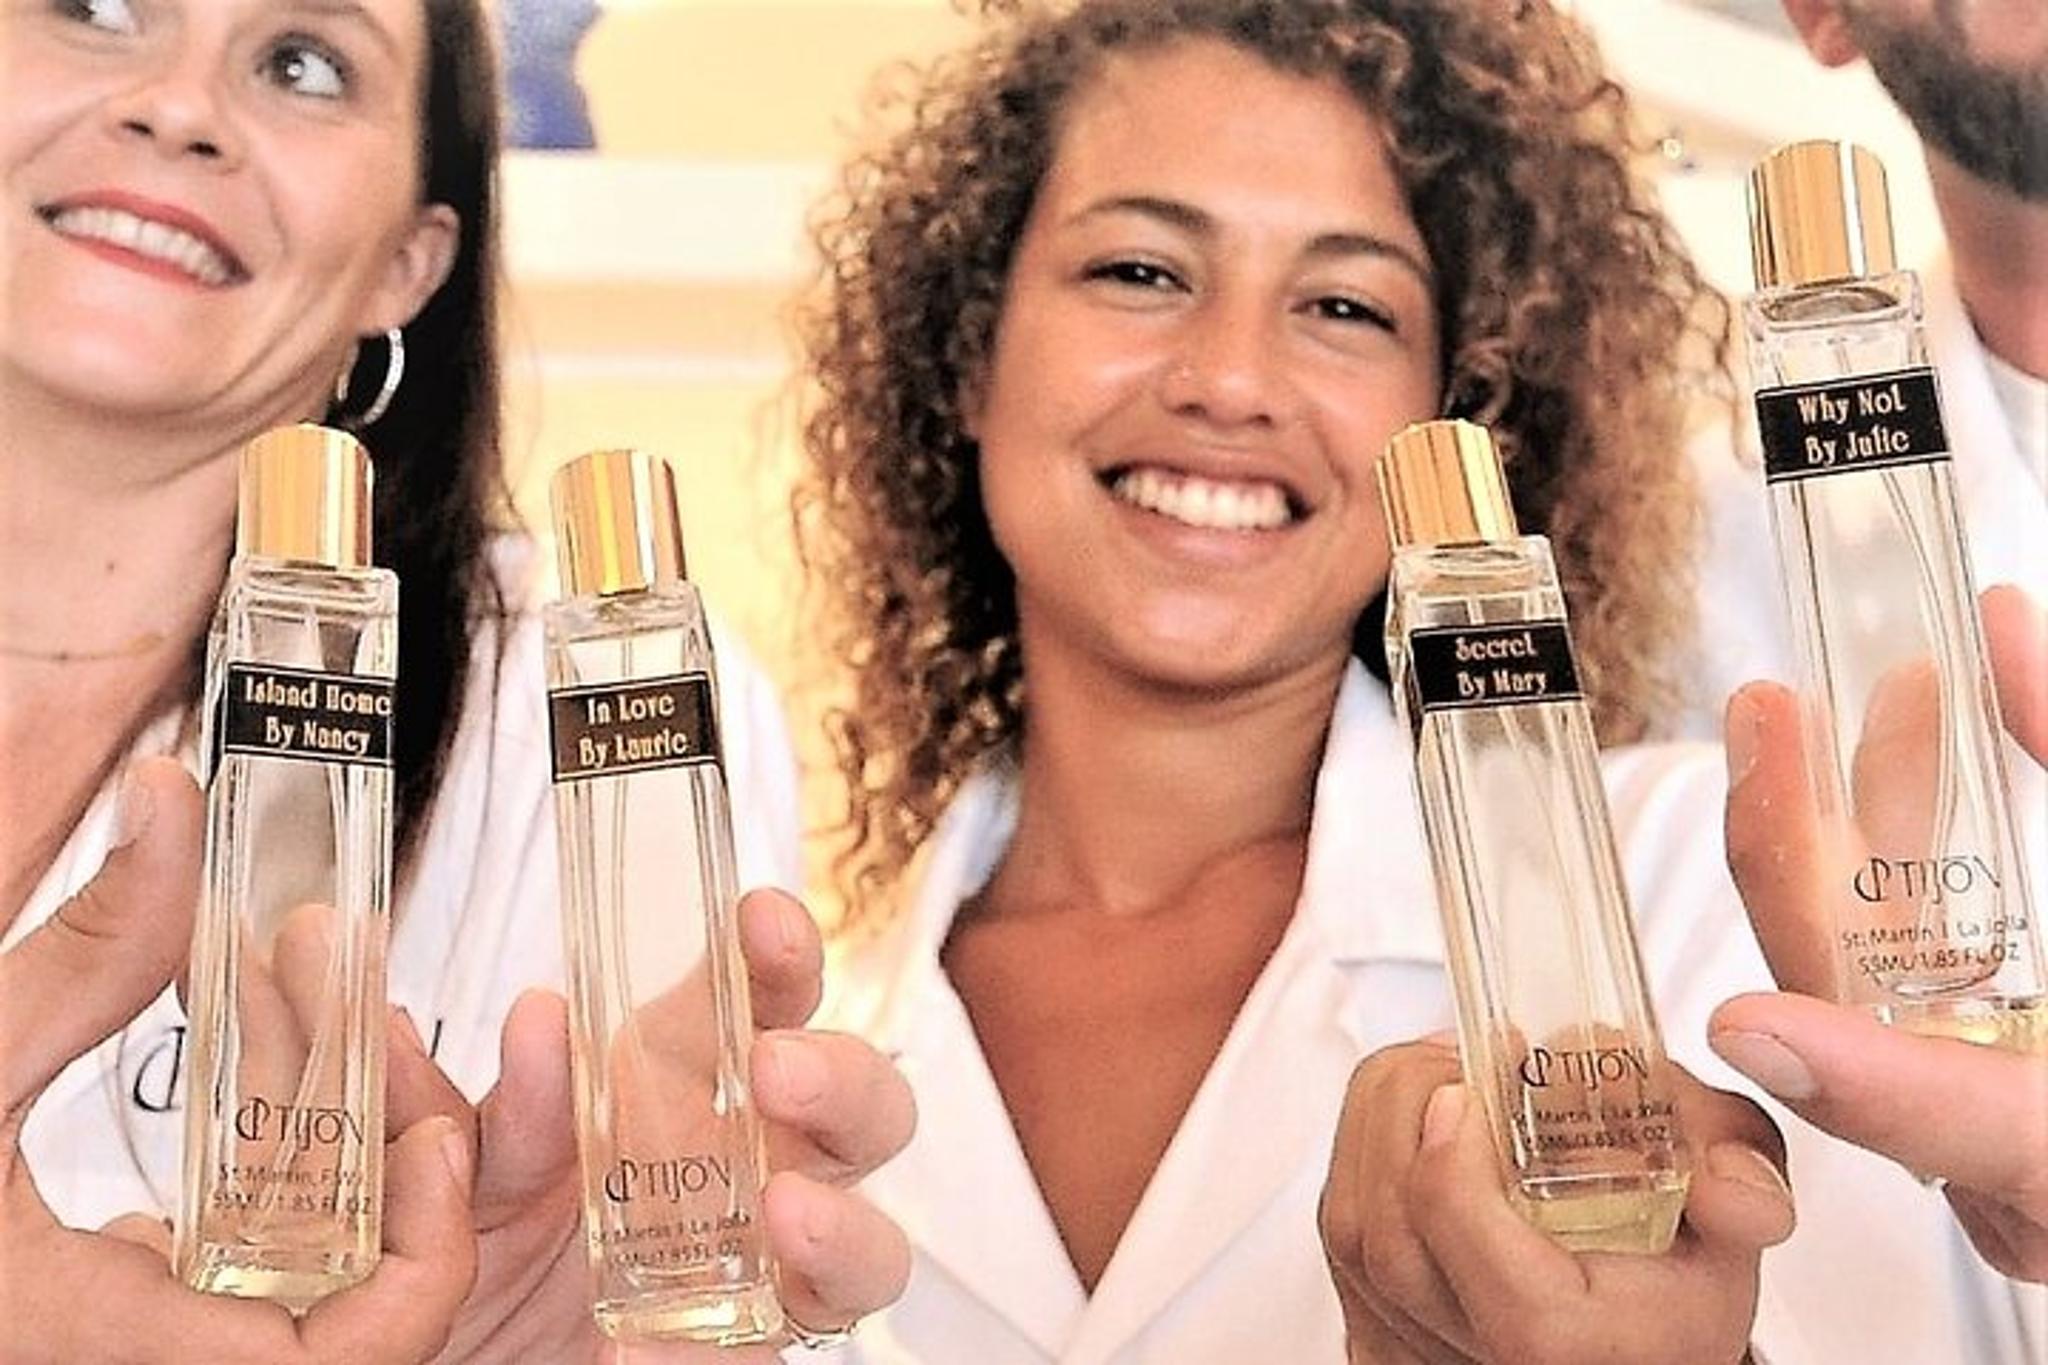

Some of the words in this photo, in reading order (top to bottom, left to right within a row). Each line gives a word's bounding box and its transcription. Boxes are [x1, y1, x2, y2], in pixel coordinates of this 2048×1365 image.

[1797, 392, 1849, 424] Why
[1805, 435, 1837, 468] By
[1846, 424, 1909, 460] Julie
[1455, 632, 1539, 662] Secret
[245, 675, 317, 708] Island
[326, 685, 392, 715] Home
[1456, 670, 1485, 699] By
[1492, 668, 1547, 695] Mary
[587, 697, 611, 725] In
[619, 693, 675, 722] Love
[266, 716, 294, 749] By
[303, 720, 371, 755] Nancy
[579, 736, 608, 768] By
[616, 728, 688, 762] Laurie
[1869, 926, 1935, 945] Martin
